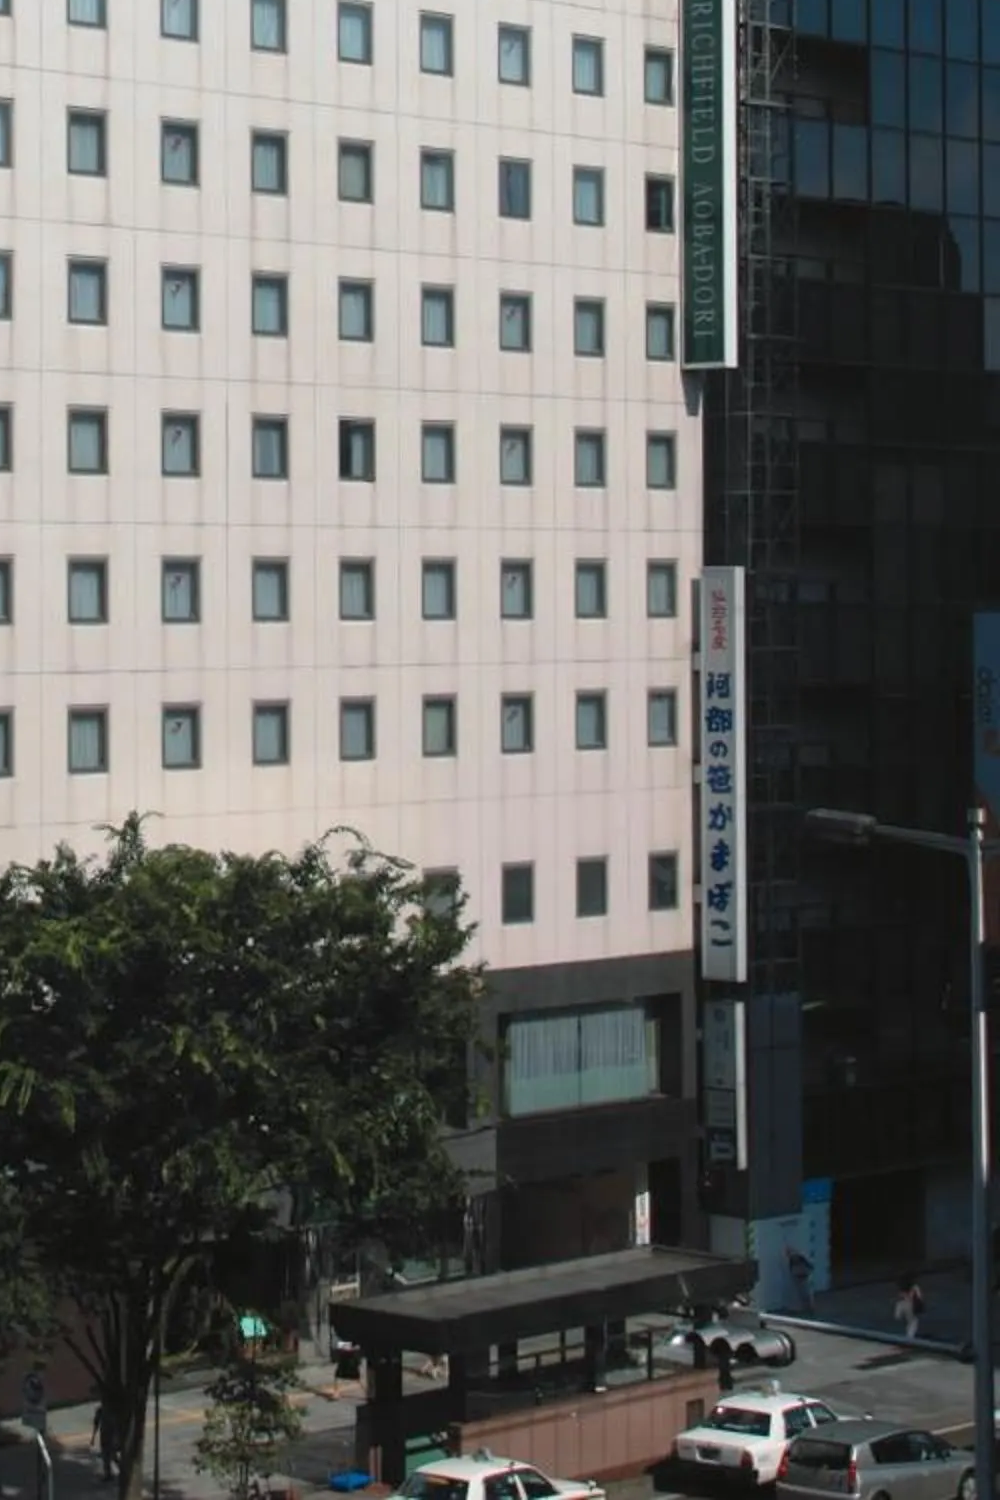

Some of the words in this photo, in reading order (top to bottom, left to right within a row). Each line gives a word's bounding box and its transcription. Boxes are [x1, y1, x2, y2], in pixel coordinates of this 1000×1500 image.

[691, 2, 715, 164] RICHFIELD
[692, 183, 716, 339] AOBA-DORI
[705, 671, 733, 947] 阿部の笹かまぼこ
